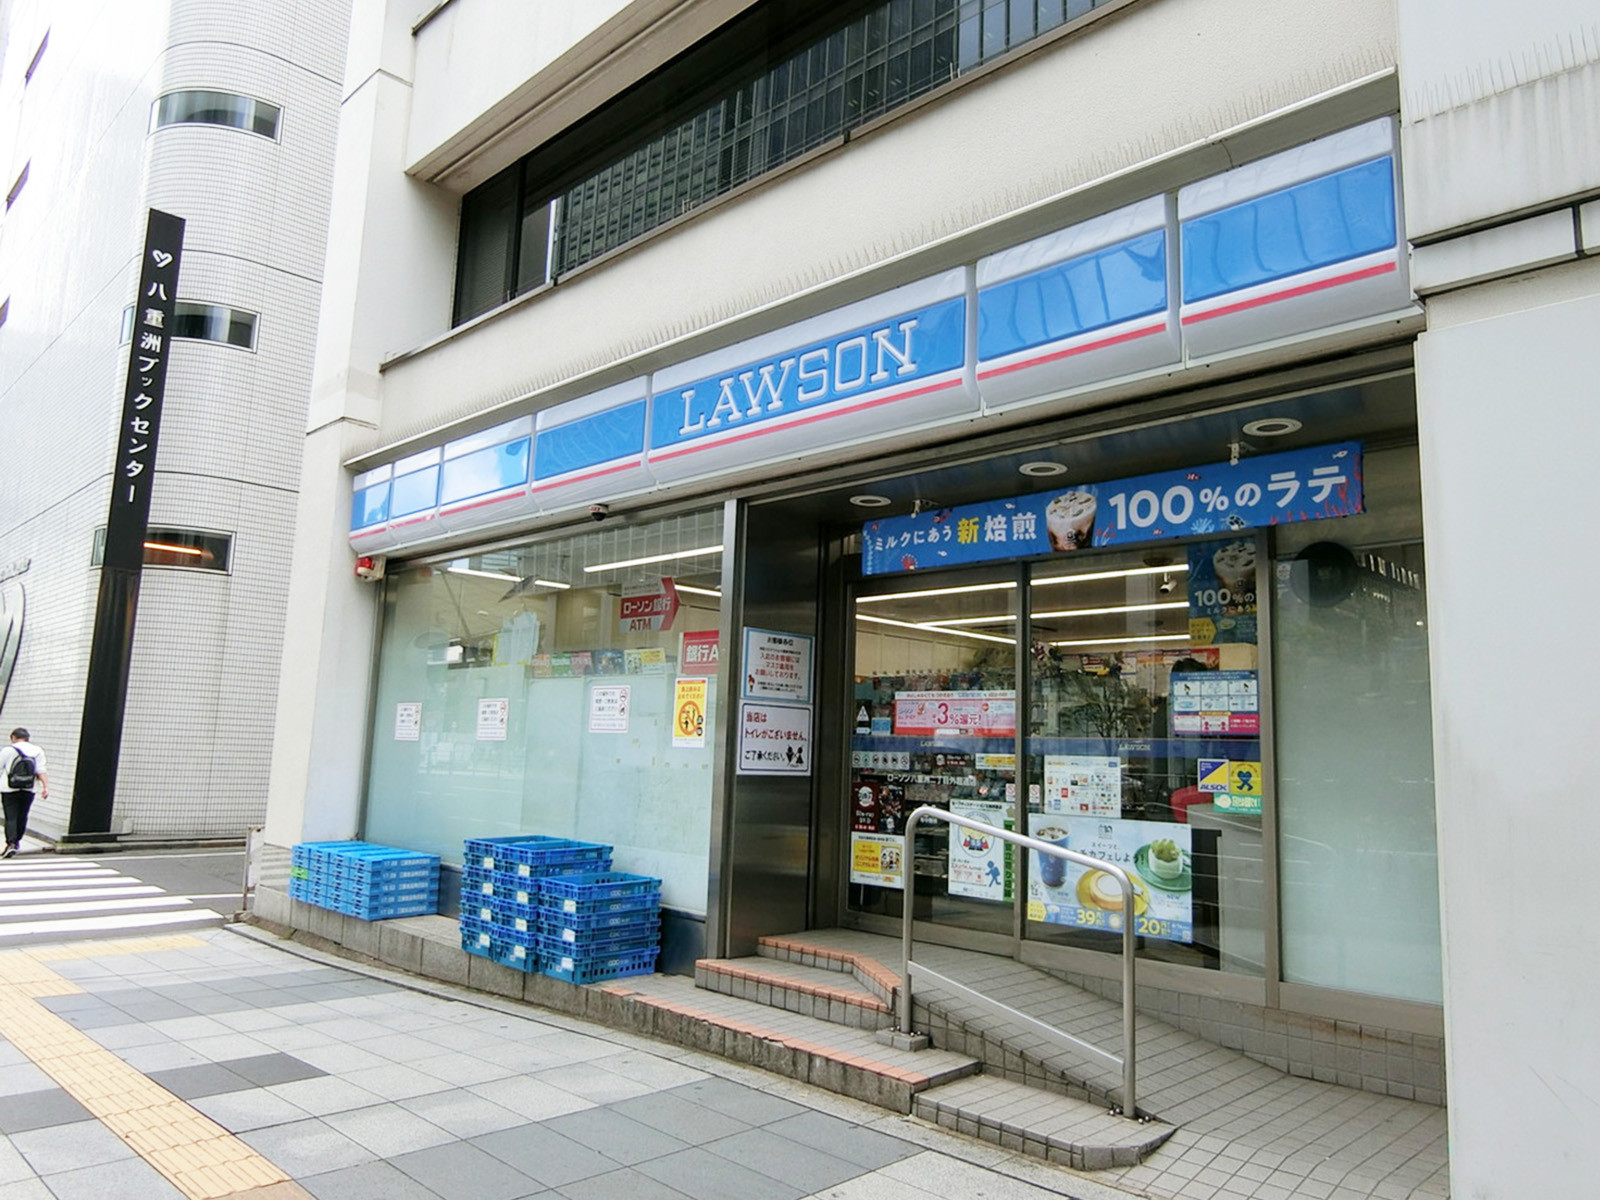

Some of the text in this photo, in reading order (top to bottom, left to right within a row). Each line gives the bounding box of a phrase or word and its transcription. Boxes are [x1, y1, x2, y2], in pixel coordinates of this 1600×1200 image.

[679, 318, 919, 436] LAWSON
[126, 282, 168, 503] 八重洲ブックセンター
[874, 524, 952, 552] ミルクにあう
[1107, 465, 1347, 530] 100%のラテ
[623, 596, 672, 615] ローソン銀行
[629, 617, 652, 632] ATM
[1200, 783, 1227, 791] ALSOK
[1138, 917, 1161, 935] 20
